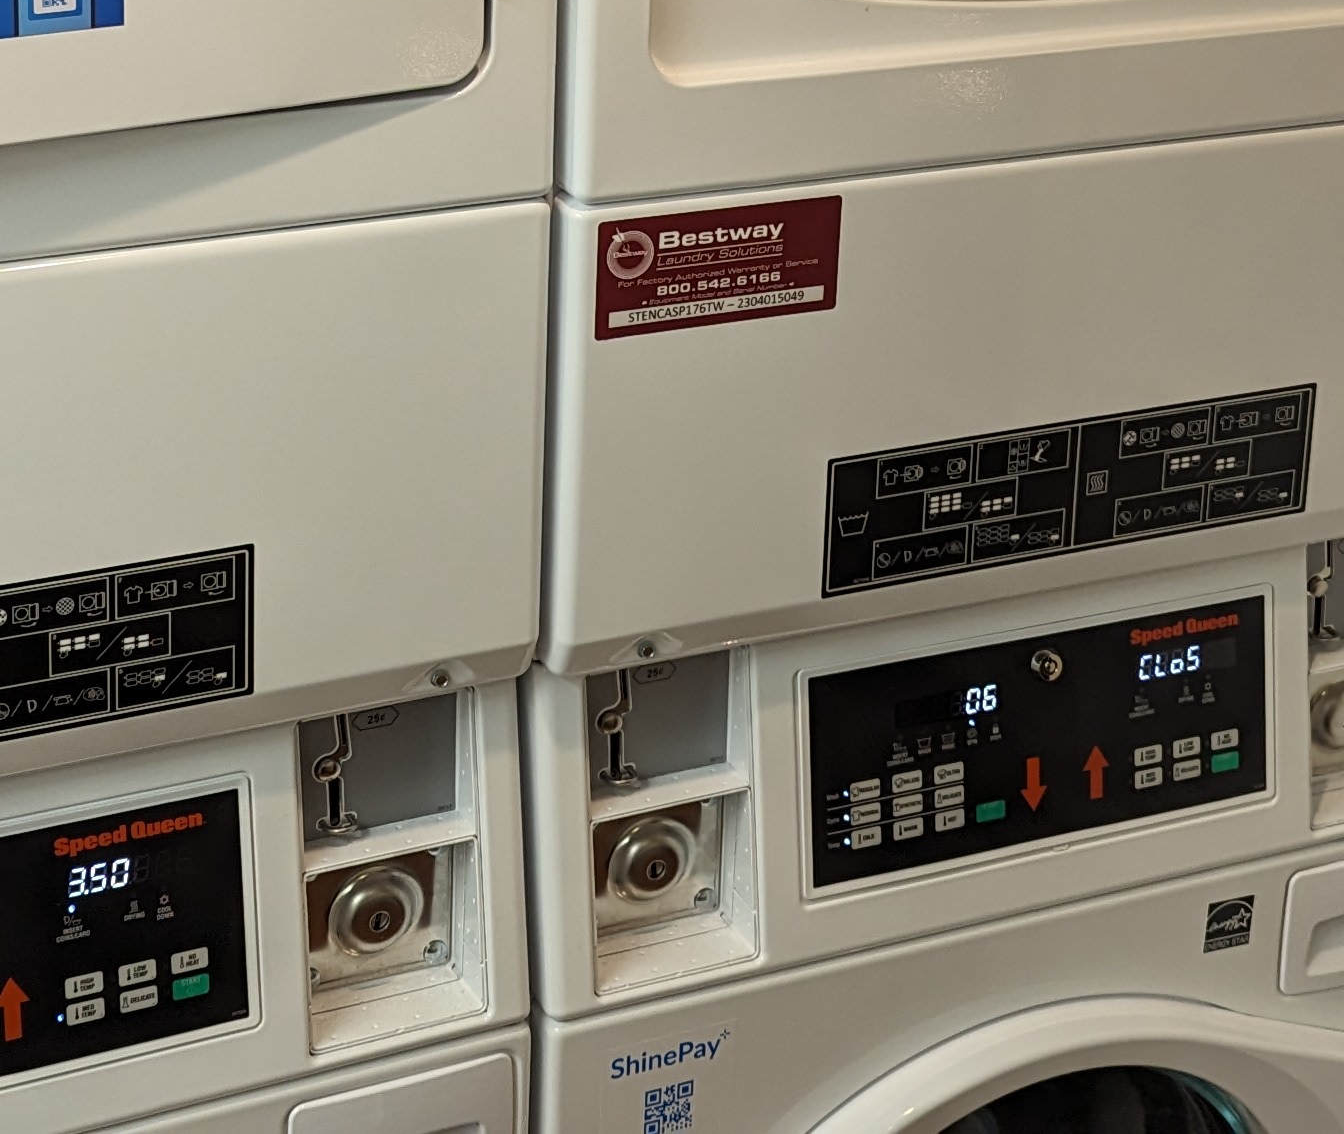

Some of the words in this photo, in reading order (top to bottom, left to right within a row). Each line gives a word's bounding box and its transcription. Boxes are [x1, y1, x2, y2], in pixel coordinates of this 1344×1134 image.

[659, 223, 784, 249] Bestway
[657, 252, 714, 266] Laundry
[719, 244, 783, 258] Solutions
[637, 276, 673, 286] Factory
[675, 269, 725, 281] Authorized
[728, 265, 770, 274] Warranty
[657, 271, 781, 296] 800.542.6166
[628, 299, 725, 323] STENCASP176TW
[737, 291, 804, 309] 2304015049
[1130, 621, 1183, 646] Speed
[1186, 614, 1239, 633] Queen
[965, 684, 998, 715] 06
[54, 824, 127, 857] Speed
[130, 813, 203, 840] Queen
[68, 858, 130, 898] 3.50
[130, 992, 156, 1004] DELICATE
[611, 1038, 722, 1079] ShinePay
